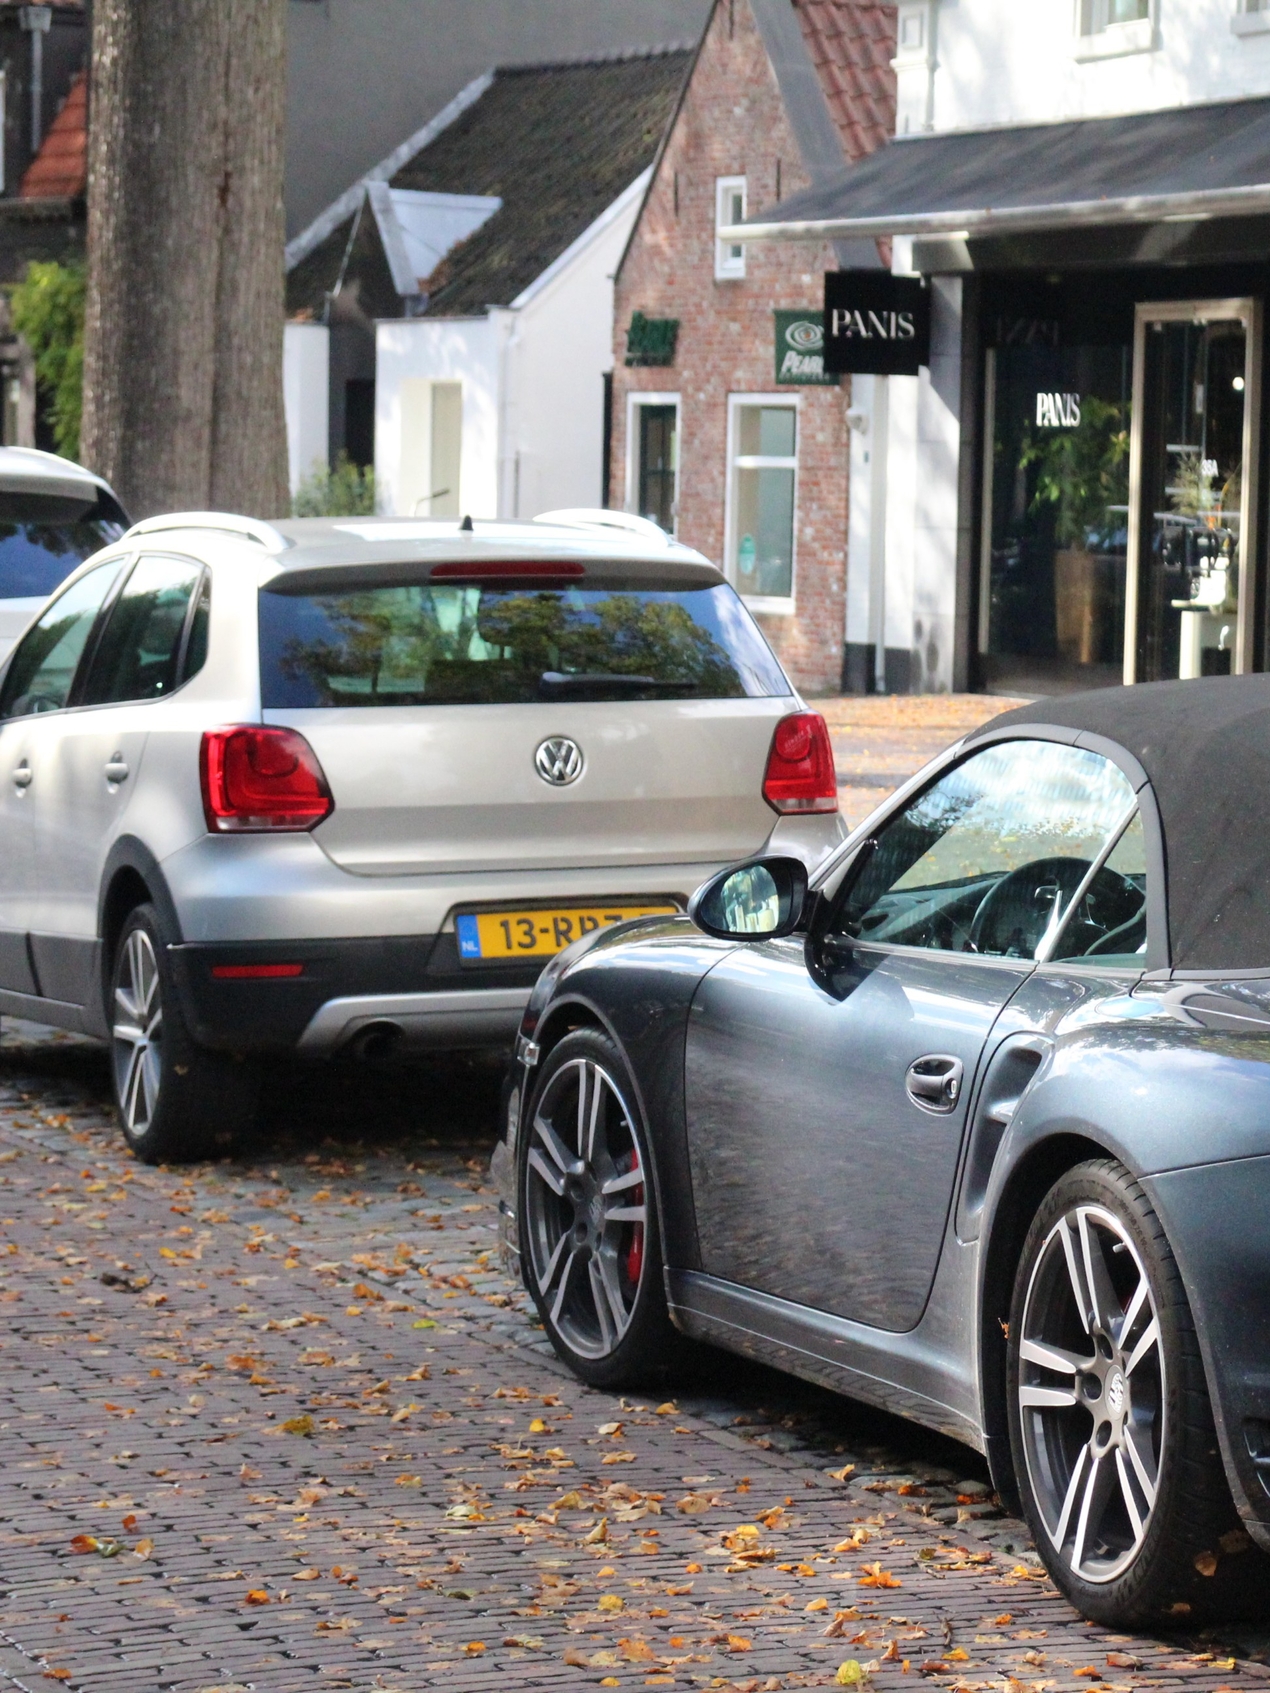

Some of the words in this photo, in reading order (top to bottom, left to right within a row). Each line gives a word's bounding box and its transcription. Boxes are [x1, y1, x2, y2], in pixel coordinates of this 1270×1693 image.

[832, 308, 916, 340] PANIS
[1036, 392, 1081, 427] PANIS
[461, 940, 479, 952] NL
